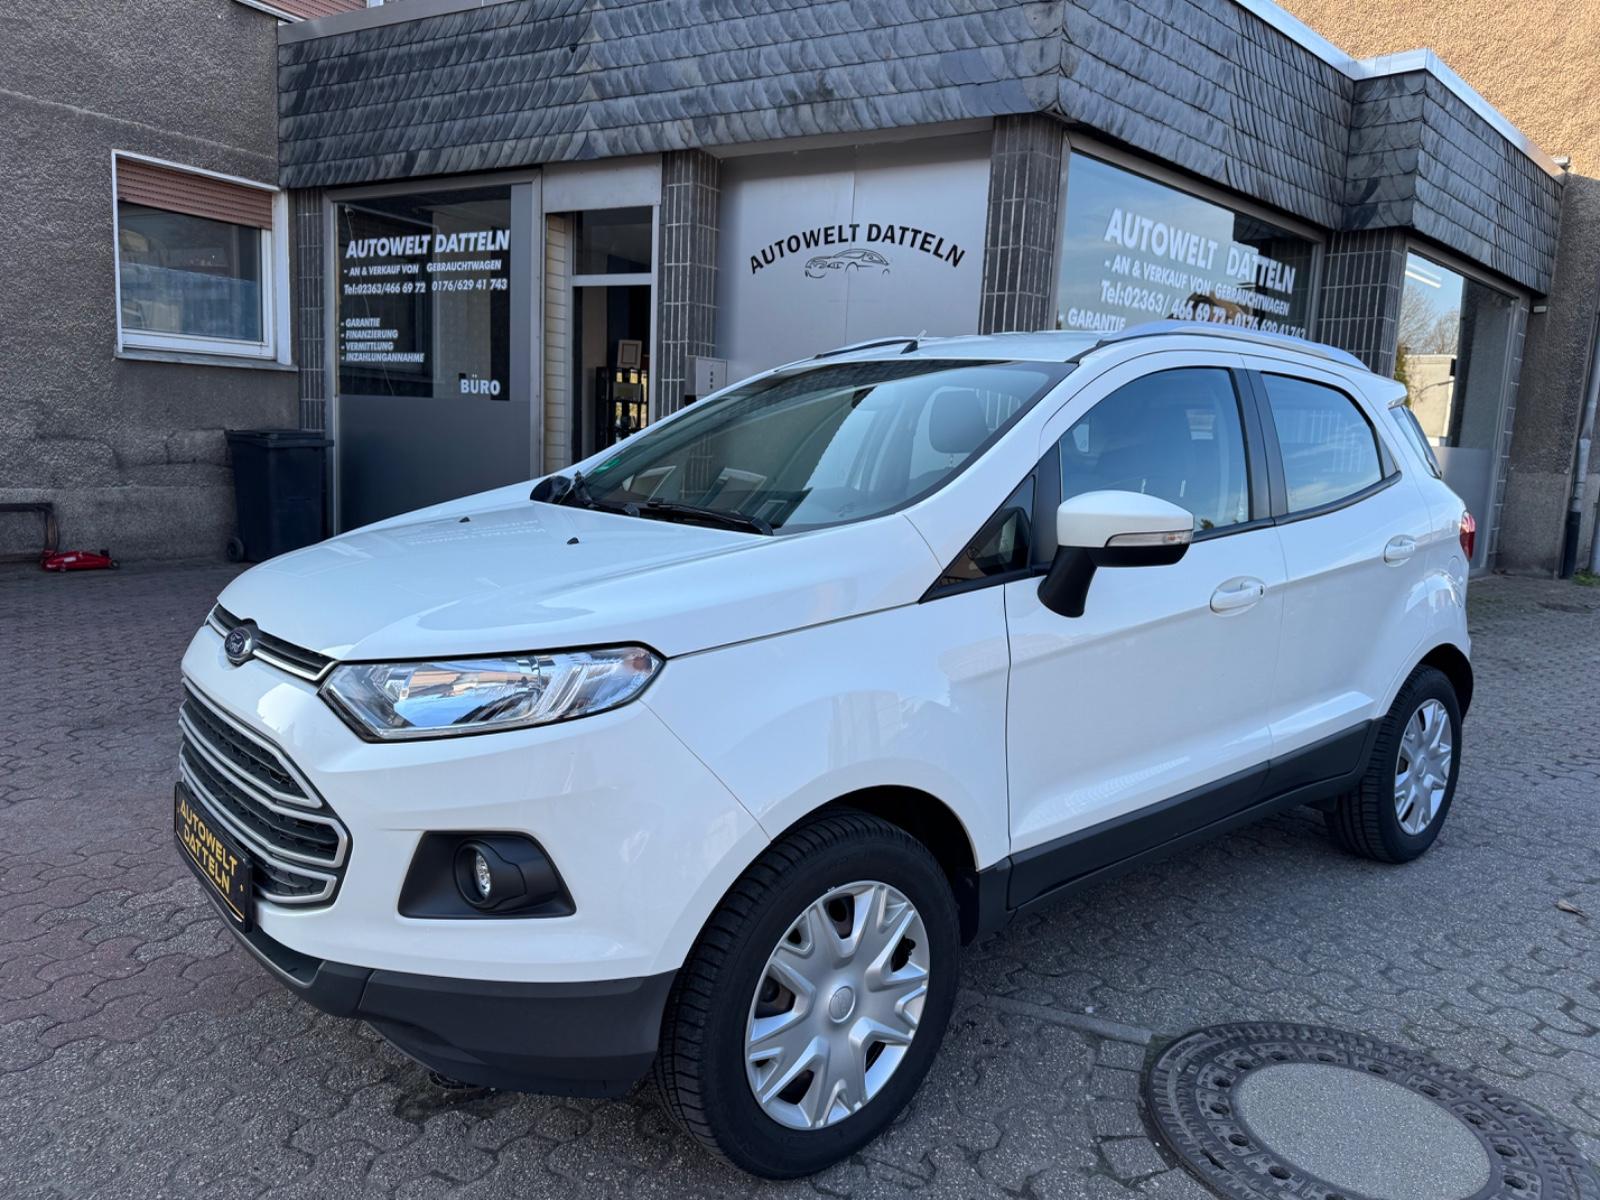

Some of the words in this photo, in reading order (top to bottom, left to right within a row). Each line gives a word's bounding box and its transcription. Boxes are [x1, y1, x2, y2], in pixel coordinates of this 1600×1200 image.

[345, 234, 431, 259] AUTOWELT
[434, 229, 510, 253] DATTELN
[749, 224, 860, 275] AUTOWELT
[866, 223, 966, 268] DATTELN
[1104, 208, 1218, 270] AUTOWELT
[1226, 246, 1296, 294] DATTELN
[349, 267, 360, 277] AN
[361, 267, 367, 276] &
[368, 265, 401, 275] VERKAUF
[401, 264, 419, 274] VON
[426, 259, 502, 272] GEBRAUCHTWAGEN
[402, 282, 413, 294] 69
[415, 282, 426, 293] 72
[432, 279, 474, 292] 0176/629
[475, 279, 487, 290] 41
[489, 279, 508, 290] 743
[1111, 255, 1131, 276] AN
[1132, 261, 1141, 277] &
[1143, 262, 1189, 289] VERKAUF
[1190, 275, 1211, 297] VON
[1215, 283, 1290, 316] GEBRAUCHTWAGEN
[345, 318, 380, 327] GARANTIE
[1171, 298, 1194, 320] 466
[1195, 302, 1211, 322] 69
[1212, 306, 1227, 323] 72
[345, 329, 399, 339] FINANZIERUNG
[345, 341, 394, 351] VERMITTLUNG
[460, 373, 501, 396] BÜRO
[180, 799, 238, 876] AUTOWELT
[184, 825, 231, 894] DATTELN
